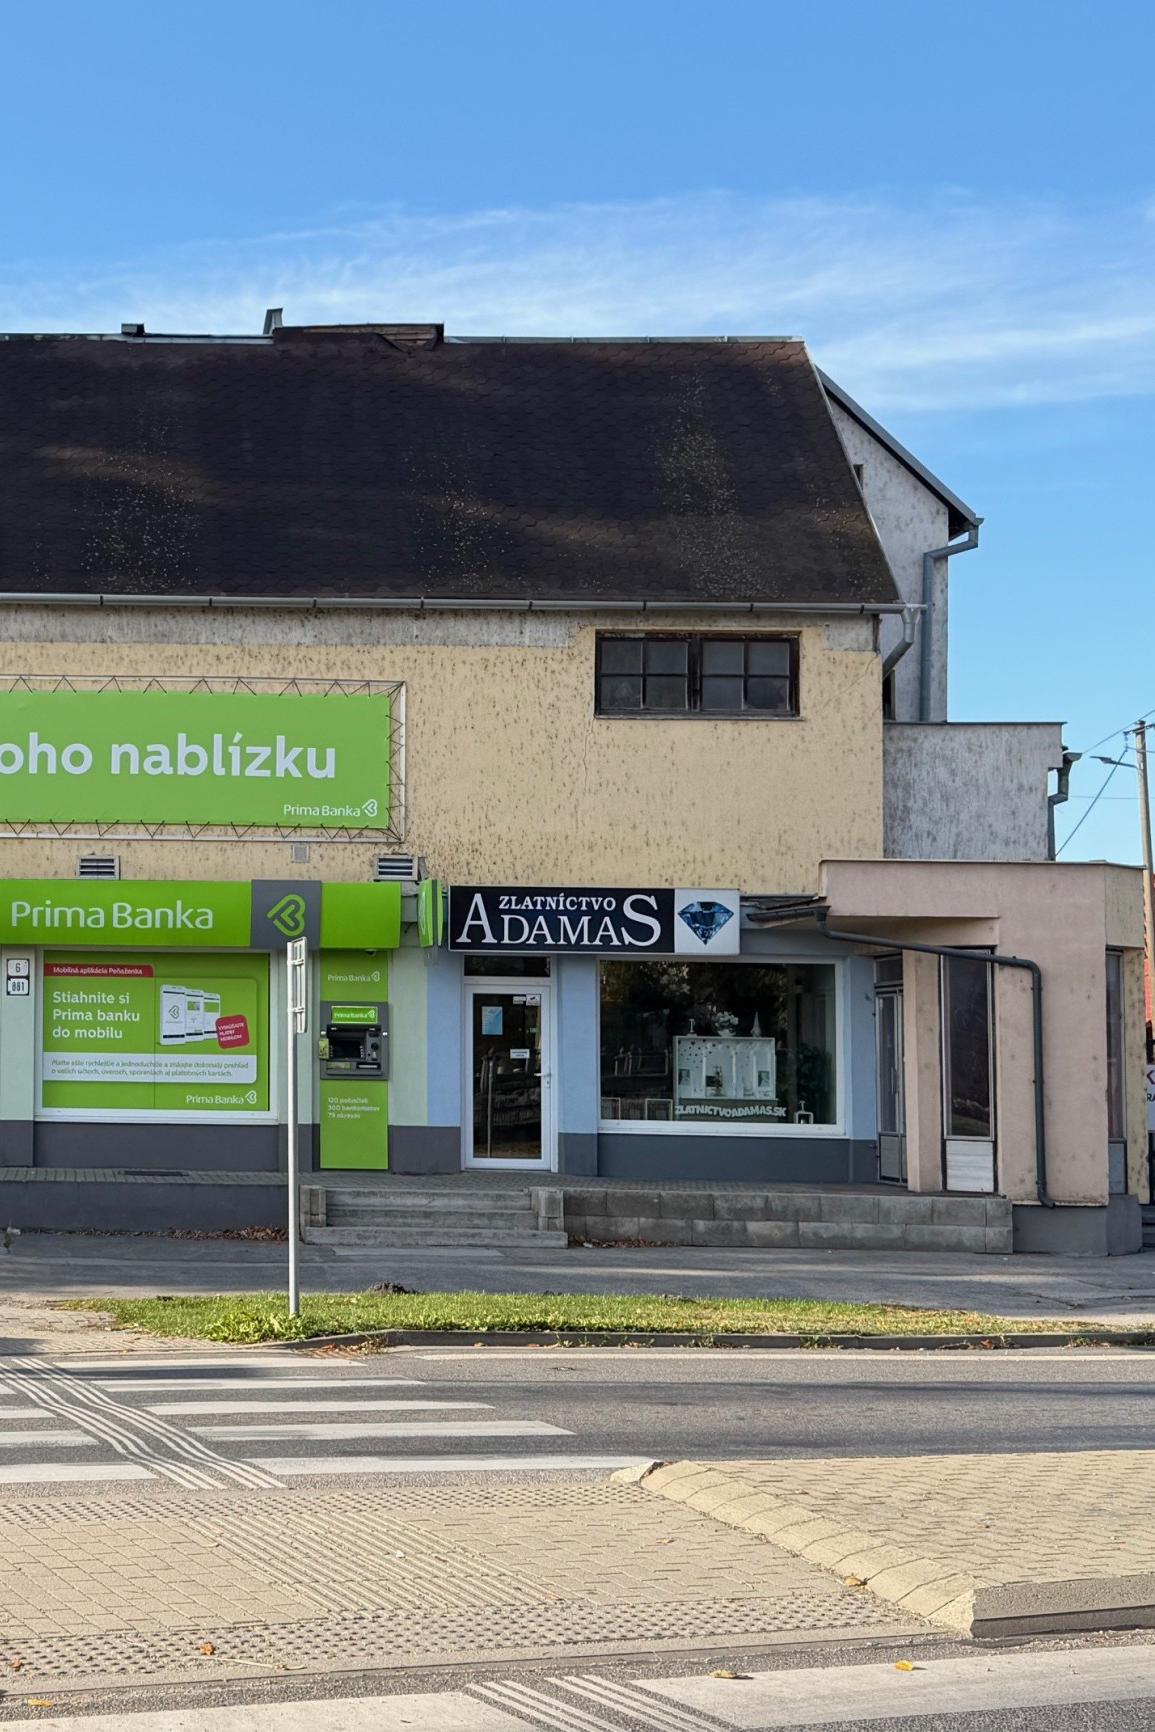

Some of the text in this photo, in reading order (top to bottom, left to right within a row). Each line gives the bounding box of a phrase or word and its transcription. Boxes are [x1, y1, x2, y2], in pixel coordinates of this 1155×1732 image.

[110, 731, 336, 779] nablízku
[283, 804, 361, 817] Prima Banka
[498, 892, 617, 911] ZLATNÍCTVO
[11, 899, 214, 929] Prima Banka
[15, 963, 21, 973] 6
[53, 966, 143, 975] Mobilná aplikácia Peňaženka
[52, 991, 130, 1004] Stiahnite si
[52, 1008, 140, 1022] Prima banku
[52, 1026, 123, 1039] do mobilu
[186, 1094, 245, 1105] Prima Banka
